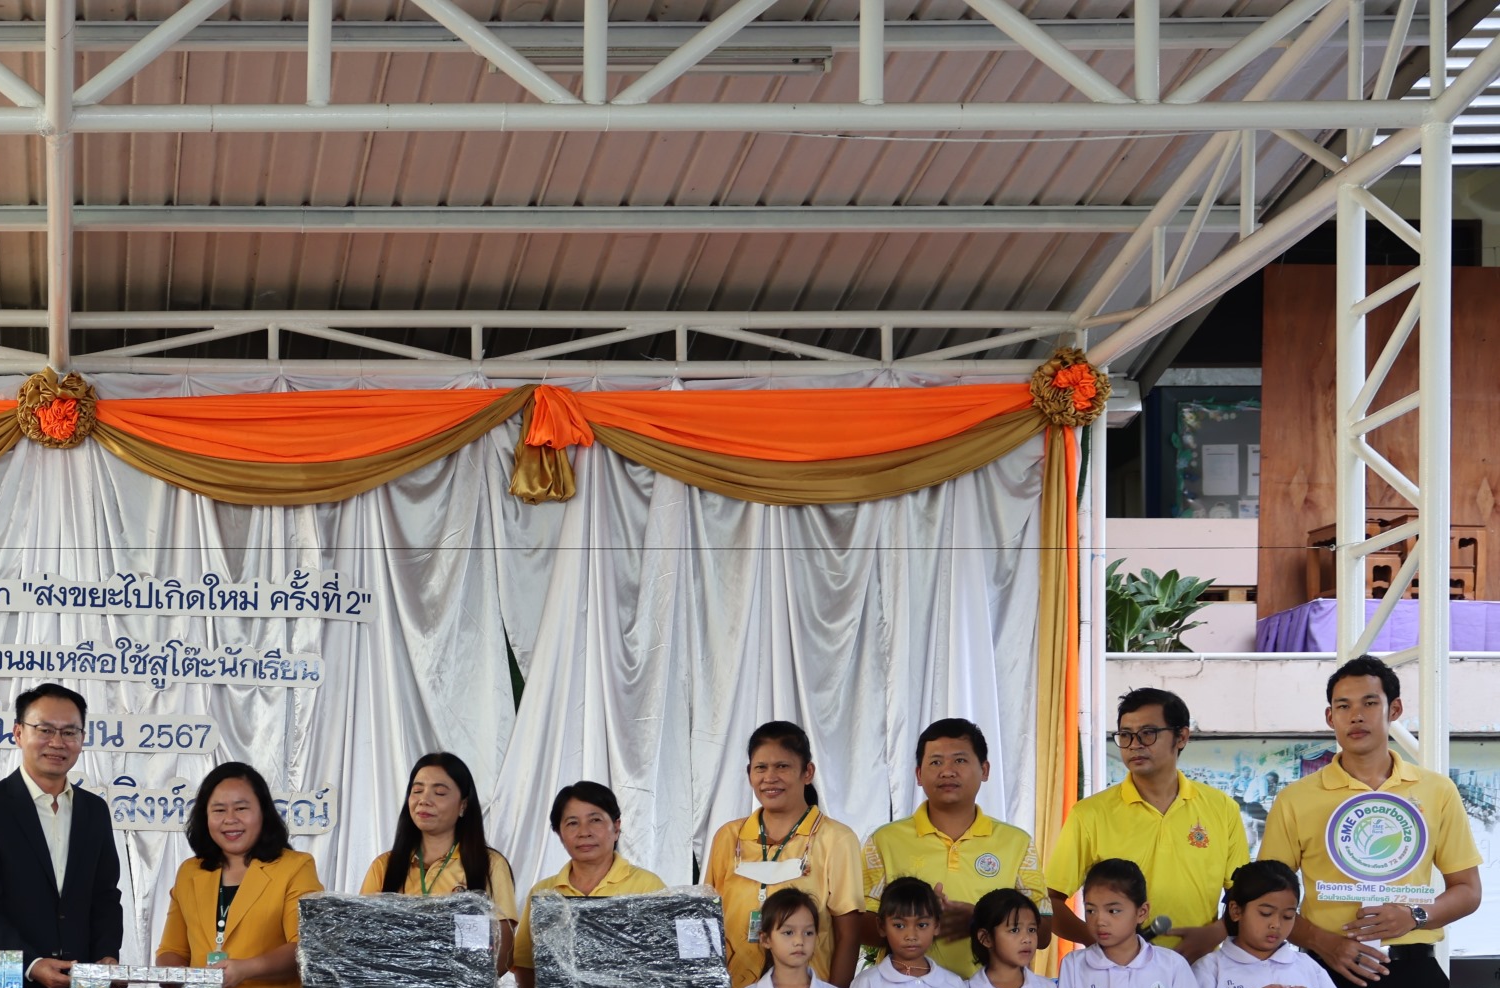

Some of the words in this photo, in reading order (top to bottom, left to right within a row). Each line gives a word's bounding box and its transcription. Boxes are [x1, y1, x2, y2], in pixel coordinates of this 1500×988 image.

[138, 723, 213, 749] 2567
[1341, 817, 1357, 843] SME
[1353, 805, 1412, 843] Decarbonize
[1316, 881, 1353, 892] โครงการ
[1356, 884, 1376, 892] SME
[1378, 884, 1435, 894] Decarbonize
[1393, 894, 1408, 903] 72
